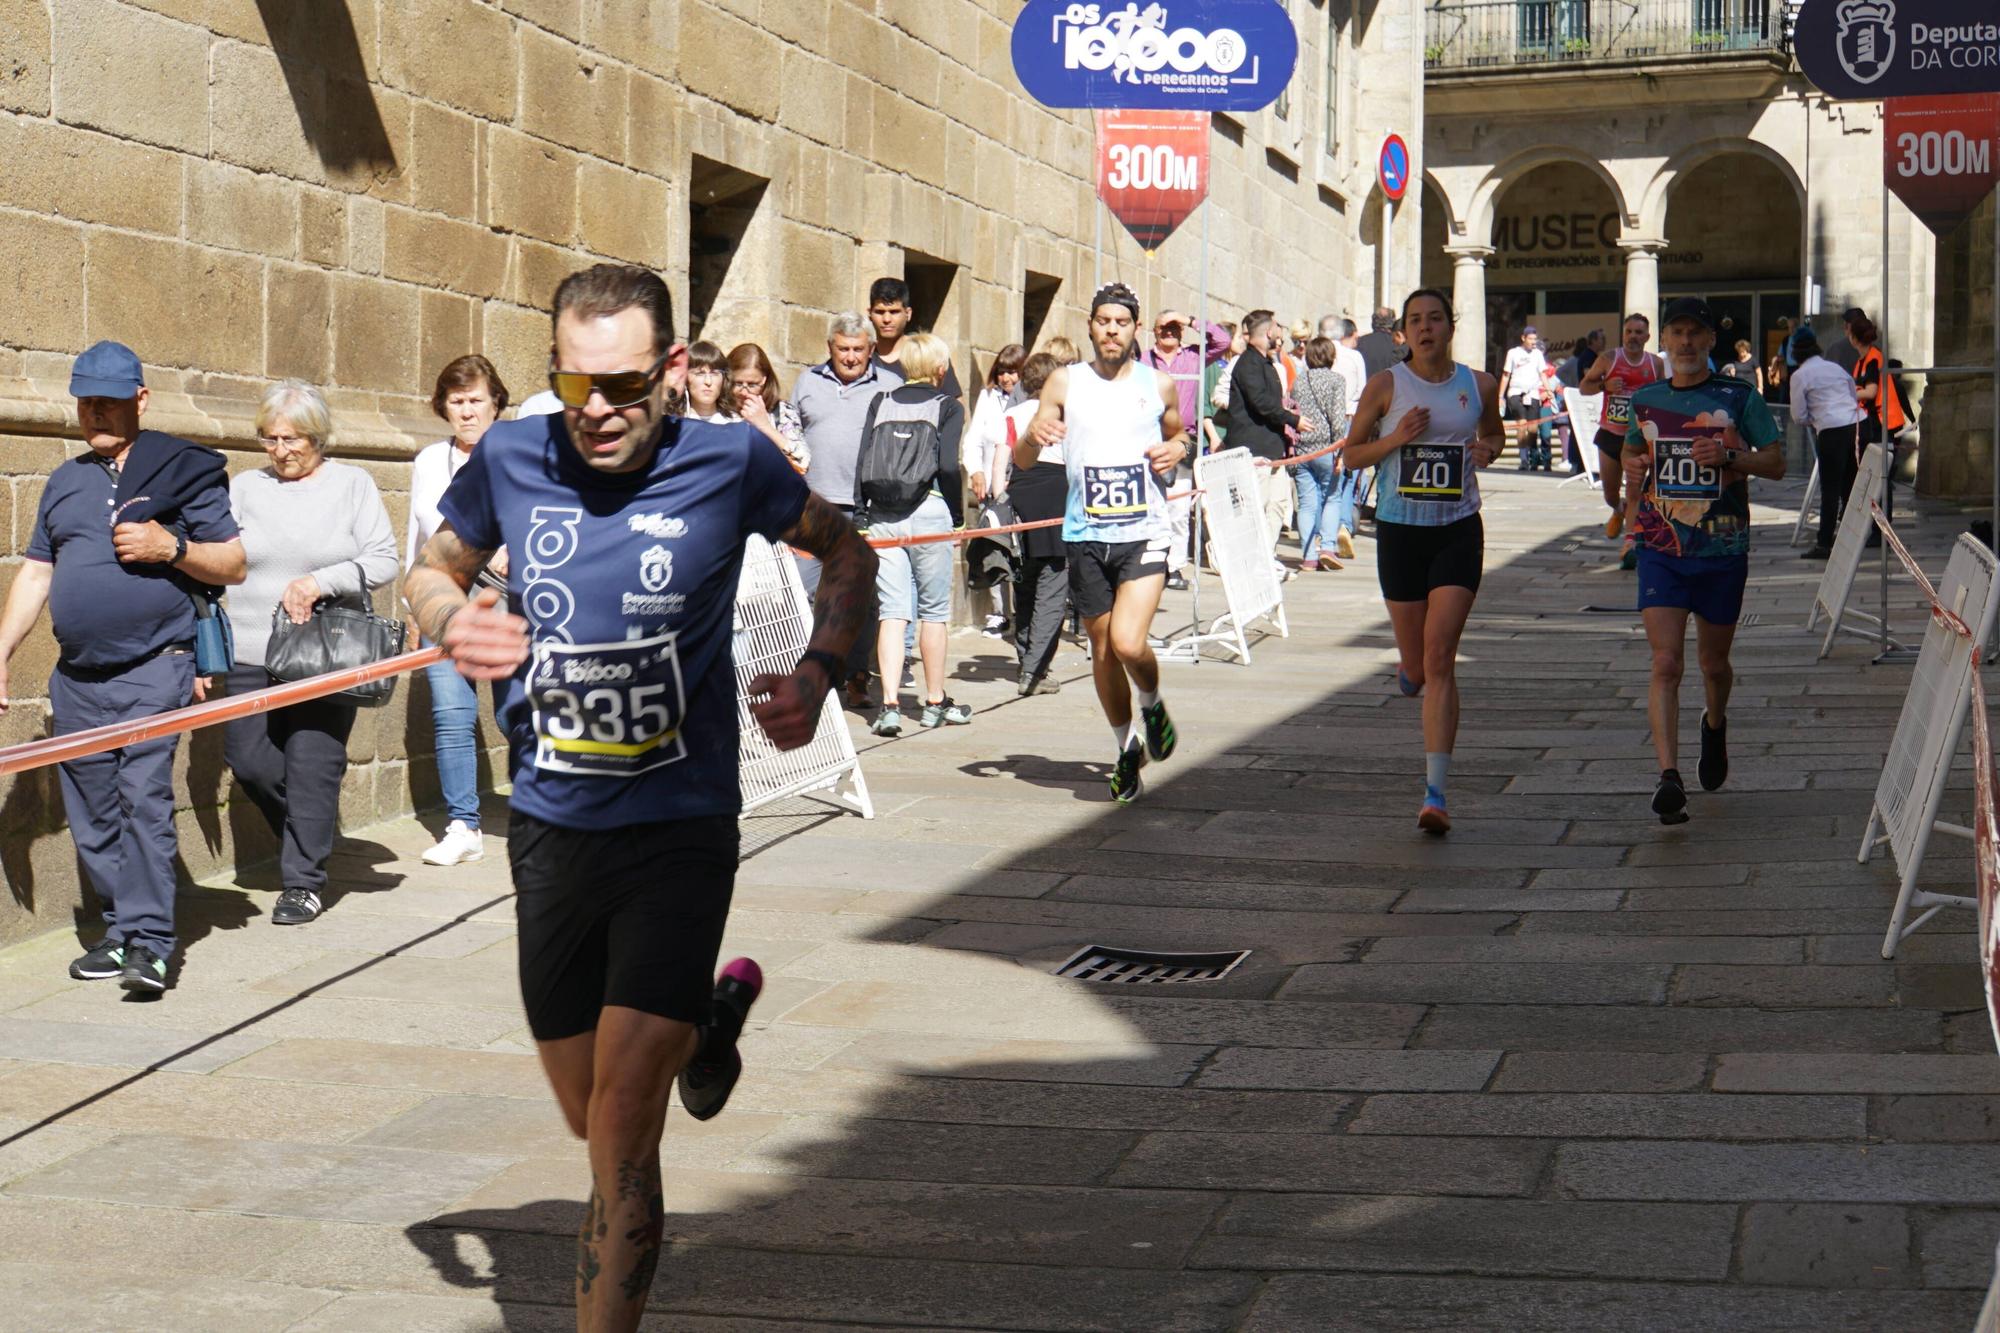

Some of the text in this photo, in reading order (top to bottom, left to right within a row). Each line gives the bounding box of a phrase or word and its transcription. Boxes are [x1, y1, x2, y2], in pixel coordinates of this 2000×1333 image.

[1911, 23, 2000, 49] Deputa
[1911, 46, 2000, 70] DA COR
[1143, 73, 1228, 86] PEREGRINOS
[1162, 86, 1196, 94] Deputación
[1206, 87, 1228, 95] Coruña
[1897, 130, 1989, 177] 300M
[1108, 144, 1197, 190] 300M
[1671, 447, 1694, 456] 10.00
[1411, 462, 1449, 488] 40
[1659, 458, 1716, 486] 405
[1091, 480, 1139, 508] 261
[542, 683, 670, 744] 335
